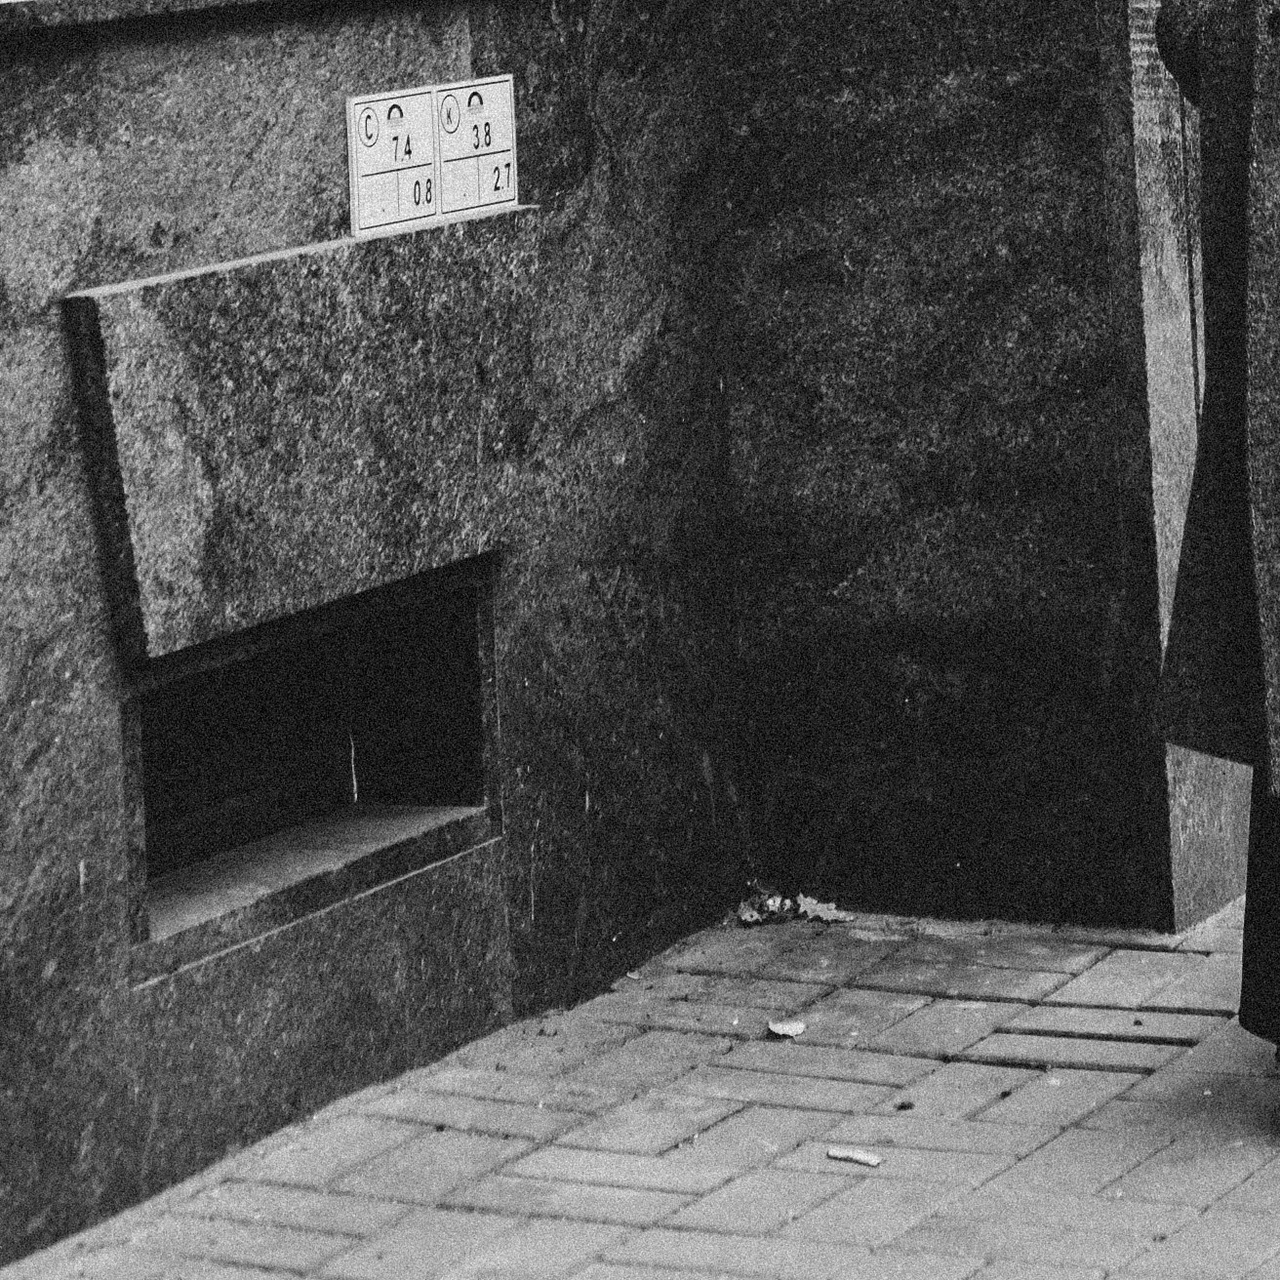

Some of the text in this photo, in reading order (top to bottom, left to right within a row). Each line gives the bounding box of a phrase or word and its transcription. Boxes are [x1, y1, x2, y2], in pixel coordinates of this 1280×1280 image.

[472, 121, 492, 150] 3.8
[493, 162, 512, 192] 2.7
[413, 178, 433, 206] 0.8
